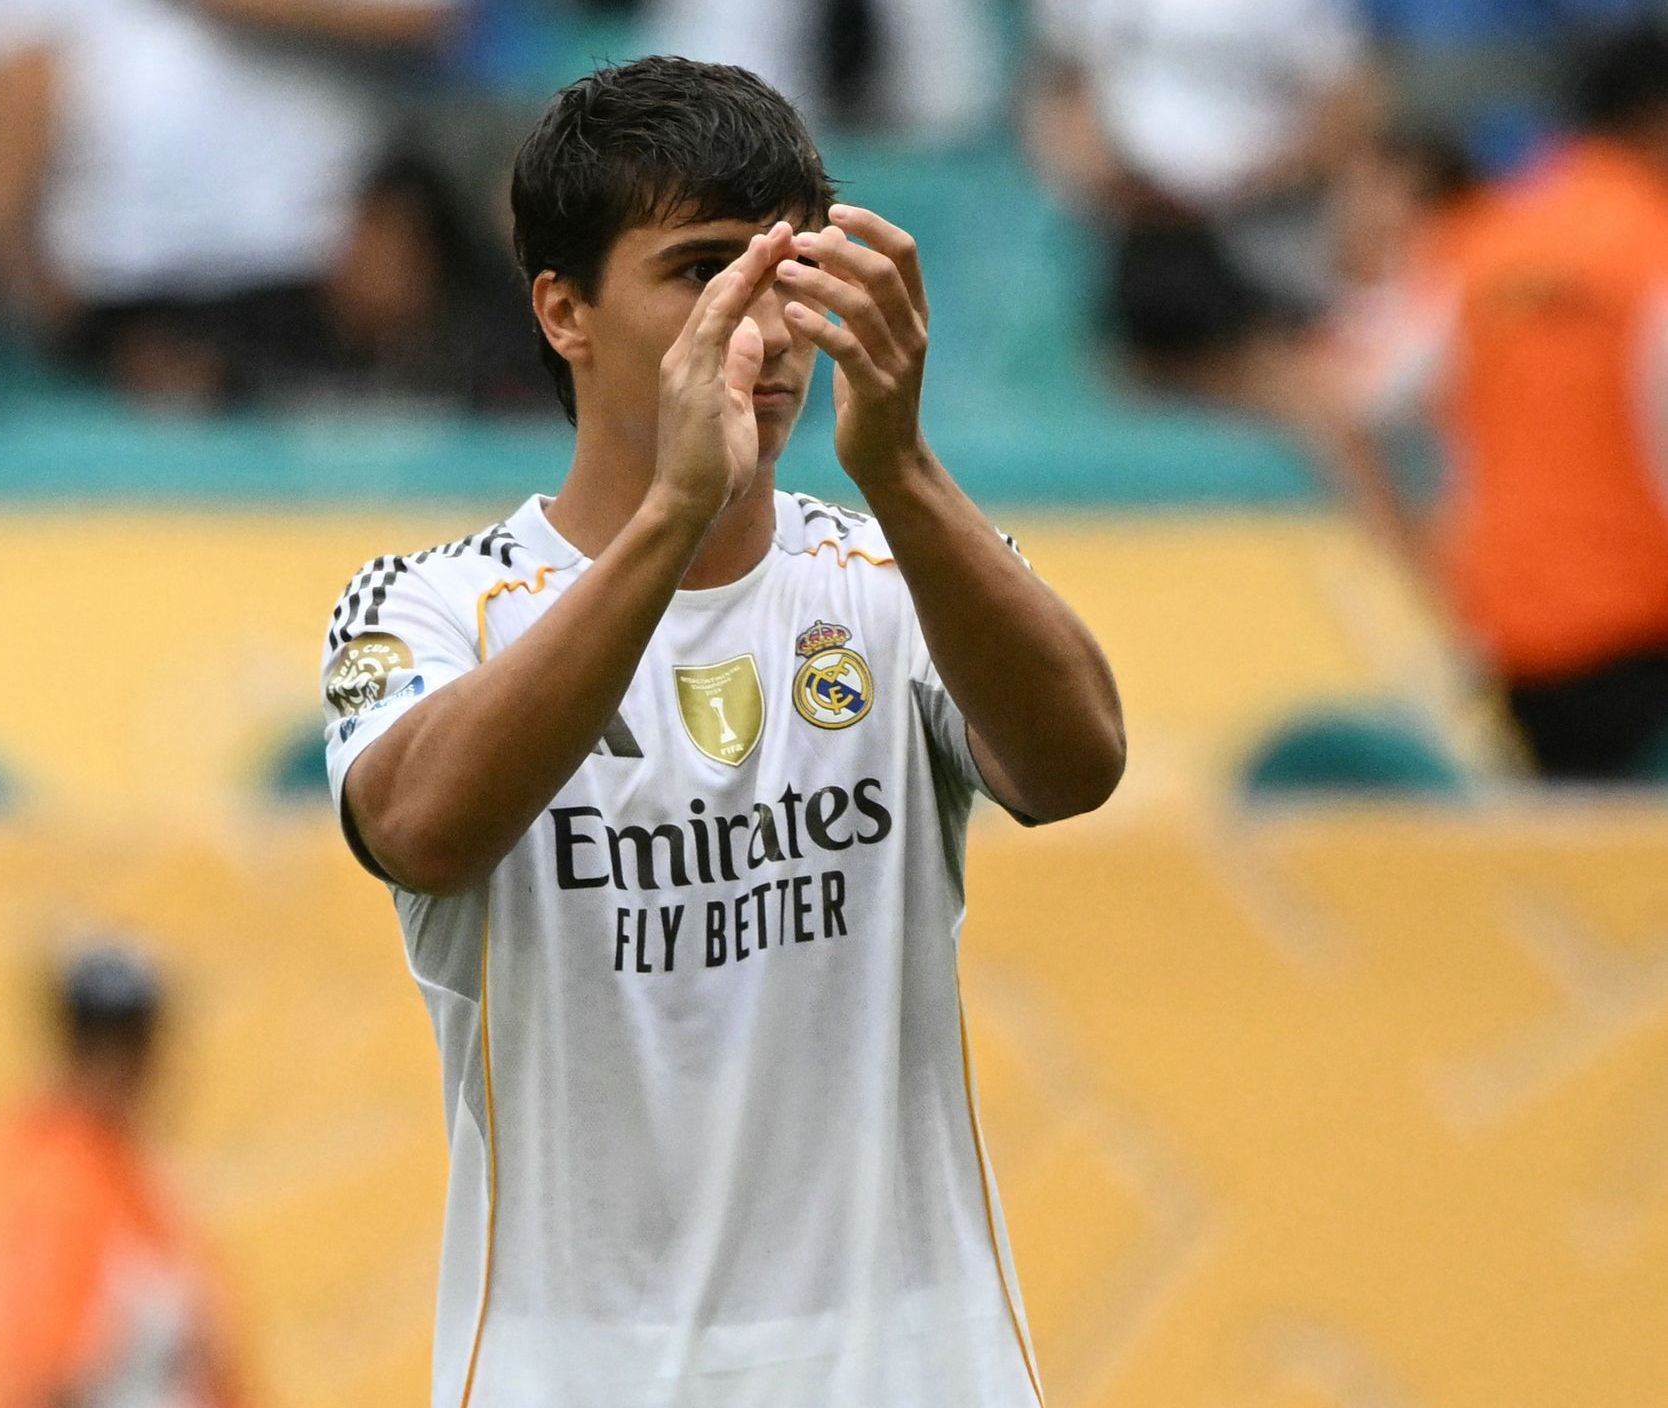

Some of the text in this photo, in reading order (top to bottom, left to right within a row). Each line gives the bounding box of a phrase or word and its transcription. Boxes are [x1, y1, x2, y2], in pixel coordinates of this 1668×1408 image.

[551, 775, 893, 891] Emirates
[614, 870, 849, 974] FLY BETTER
